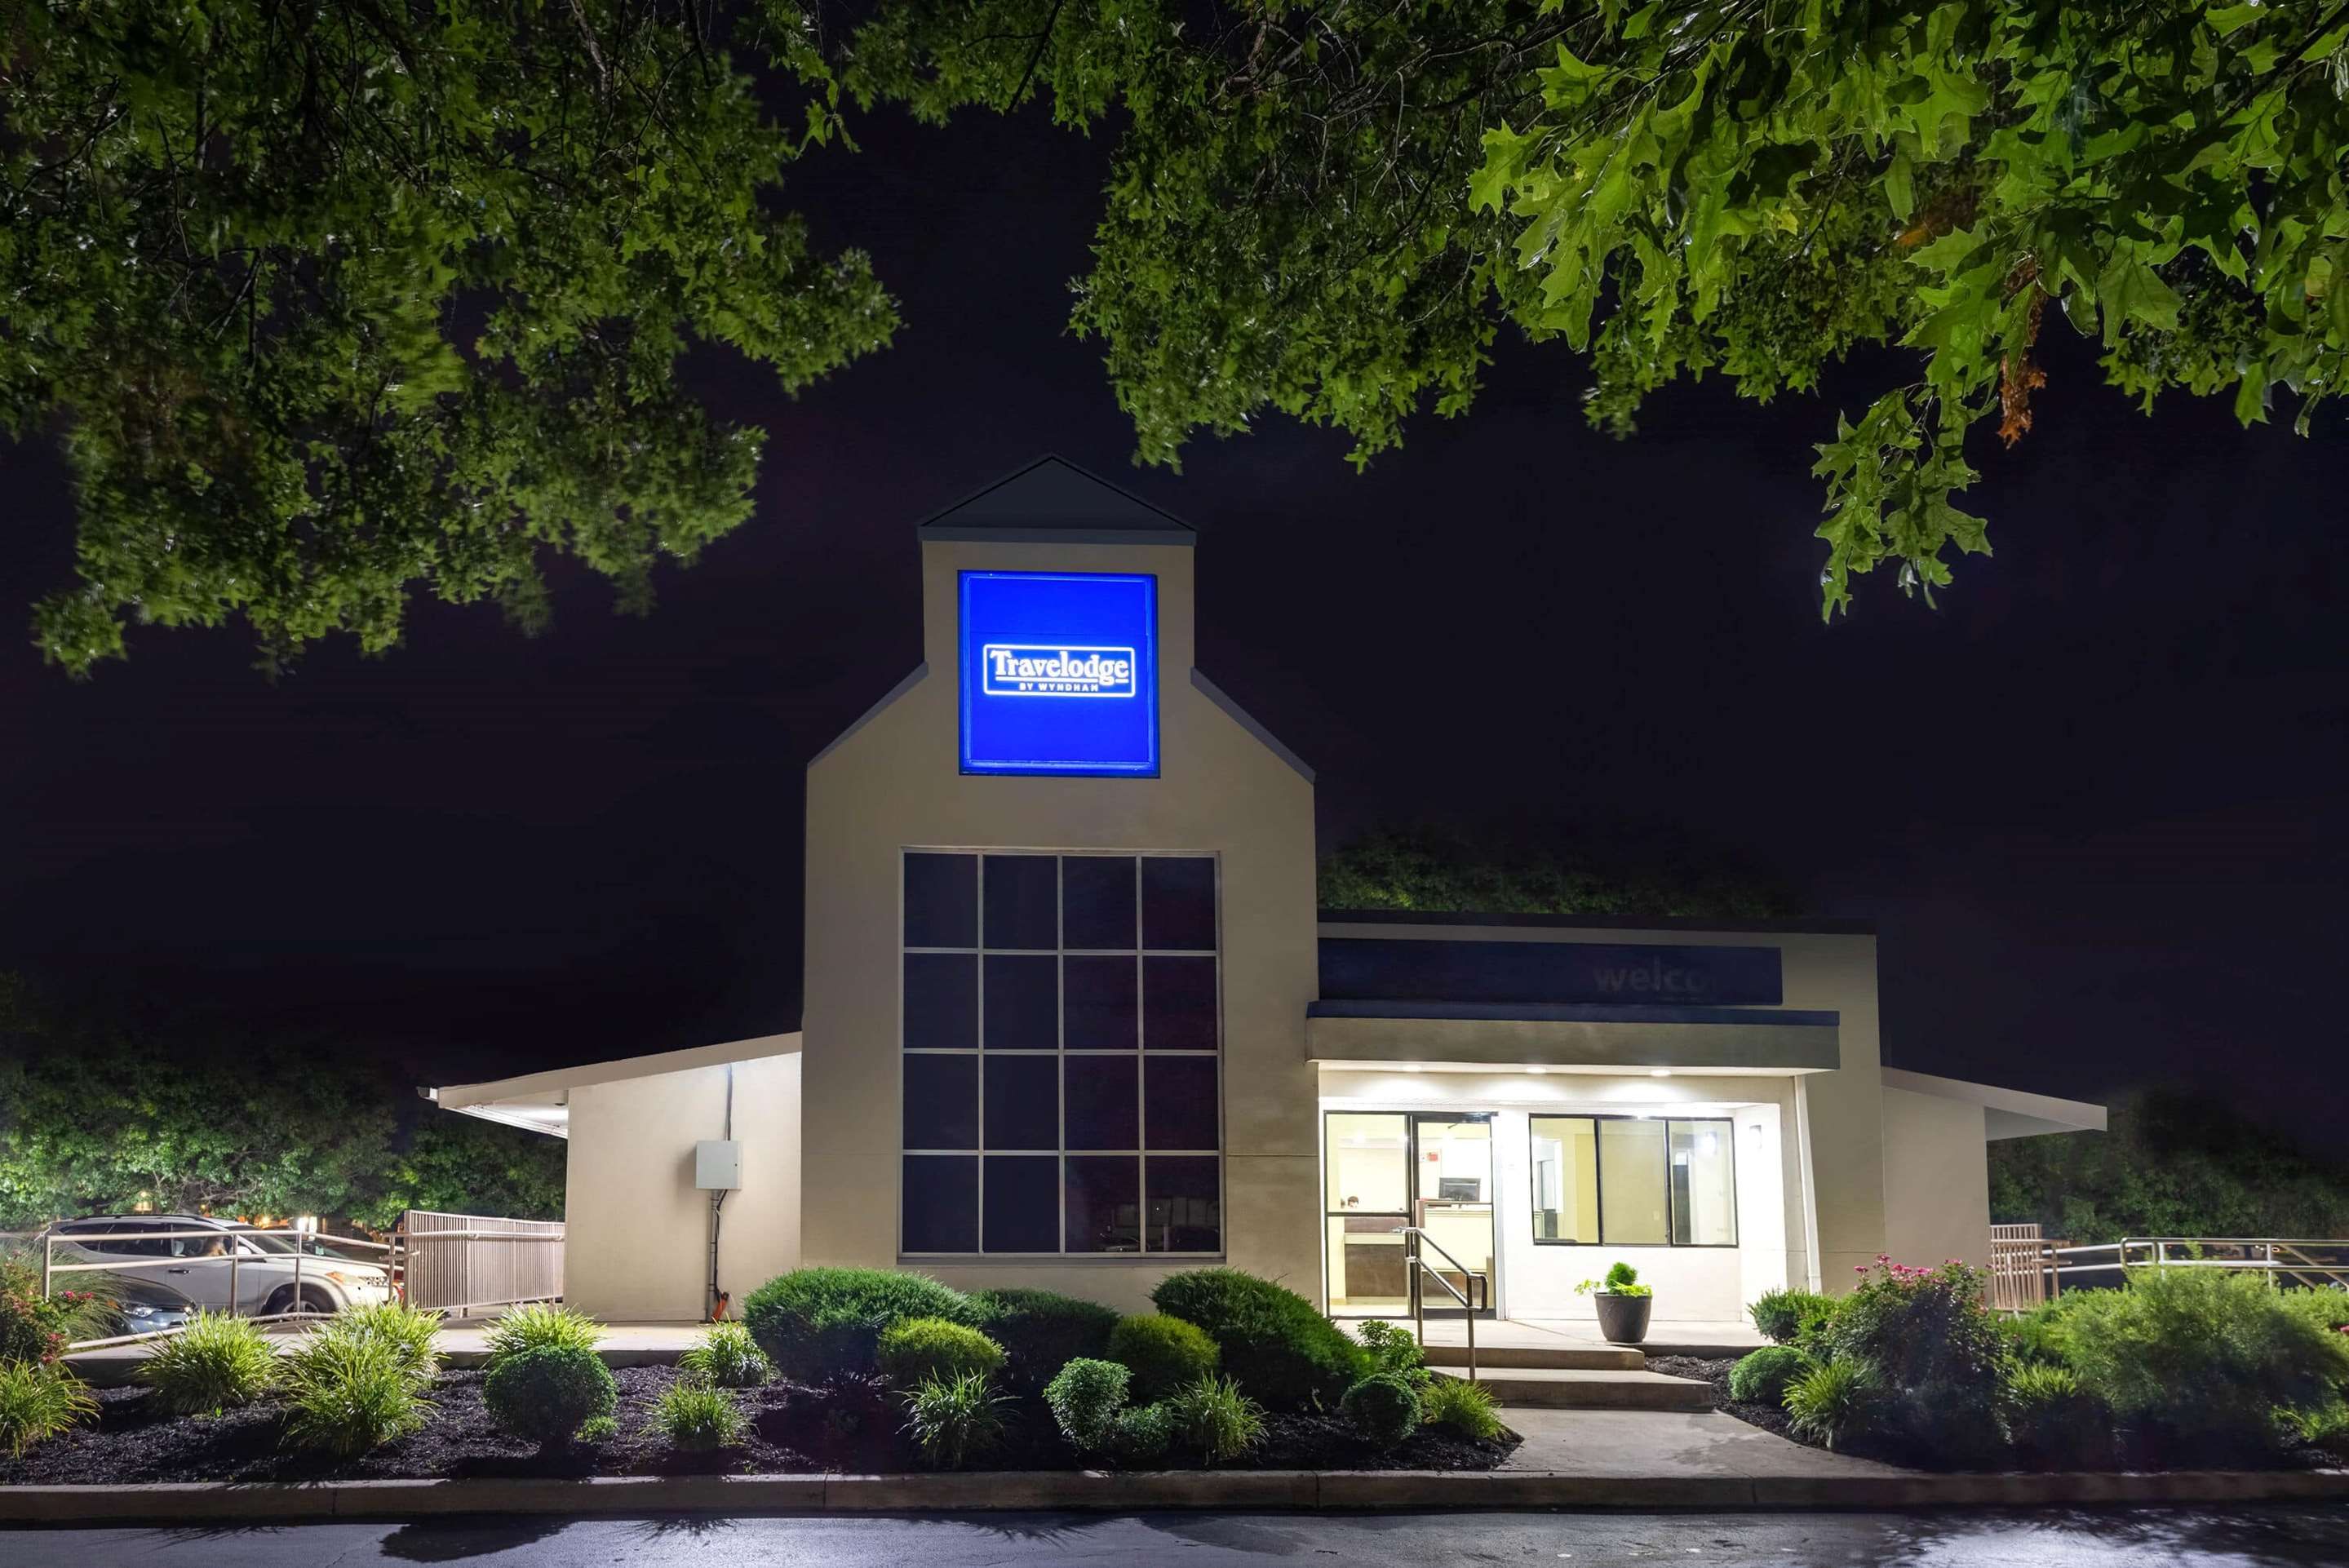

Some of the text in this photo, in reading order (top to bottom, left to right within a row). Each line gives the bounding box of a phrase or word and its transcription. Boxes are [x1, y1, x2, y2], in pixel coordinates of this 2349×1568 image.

[990, 650, 1128, 685] Travelodge
[1019, 682, 1099, 692] BY WYNDHAM
